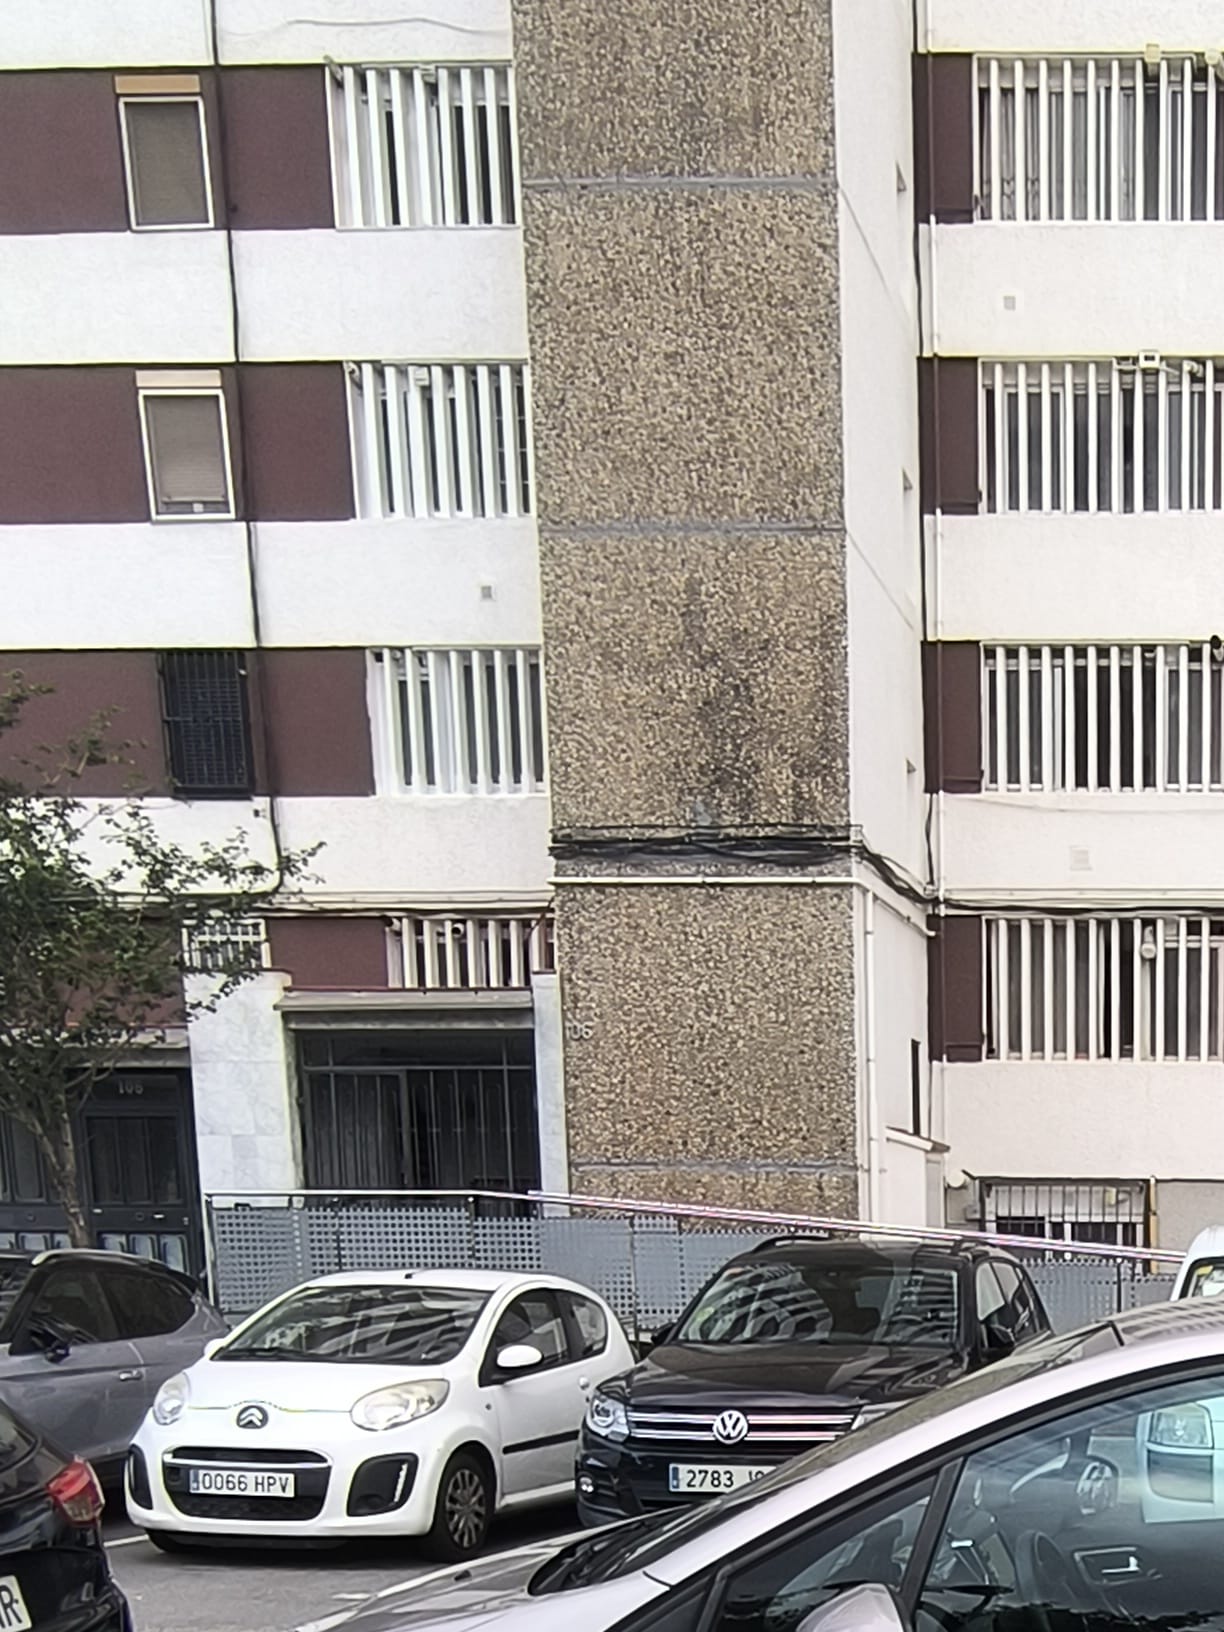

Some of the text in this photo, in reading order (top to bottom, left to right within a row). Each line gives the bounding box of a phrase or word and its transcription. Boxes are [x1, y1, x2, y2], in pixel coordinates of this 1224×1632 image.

[202, 1473, 289, 1493] 0066 HPV
[686, 1469, 734, 1488] 2783
